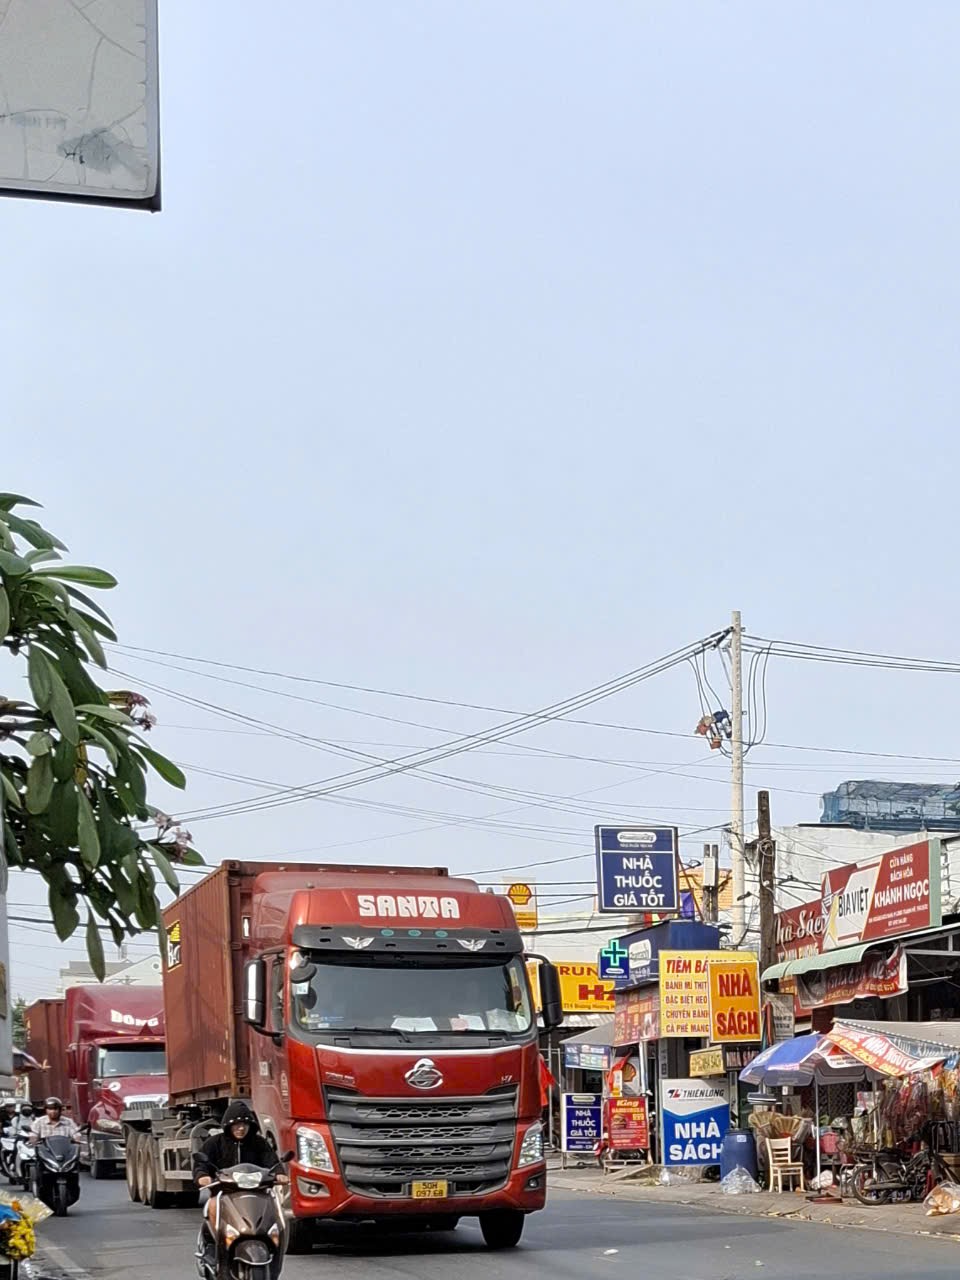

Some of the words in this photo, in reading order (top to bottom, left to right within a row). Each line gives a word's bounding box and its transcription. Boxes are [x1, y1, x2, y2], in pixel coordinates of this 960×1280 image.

[622, 854, 654, 870] NHÀ
[614, 870, 662, 888] THUỐC
[613, 891, 638, 906] GIÁ
[640, 888, 665, 906] TỐT
[838, 895, 850, 918] BIA
[850, 886, 870, 914] VIỆT
[874, 885, 903, 909] KHÁNH
[903, 879, 930, 903] NGỌC
[357, 895, 460, 918] SANTA
[775, 914, 793, 945] hà
[796, 909, 824, 940] Sác
[557, 965, 598, 976] RUN
[666, 956, 693, 978] TIỆM
[694, 956, 709, 974] BÁ
[718, 968, 753, 997] NHÀ
[716, 1007, 760, 1036] SÁCH
[571, 1117, 596, 1127] THUỐC
[575, 1109, 592, 1117] NHÀ
[570, 1128, 583, 1136] GIÁ
[584, 1127, 597, 1136] TỐT
[674, 1117, 720, 1139] NHÀ
[669, 1139, 724, 1161] SÁCH
